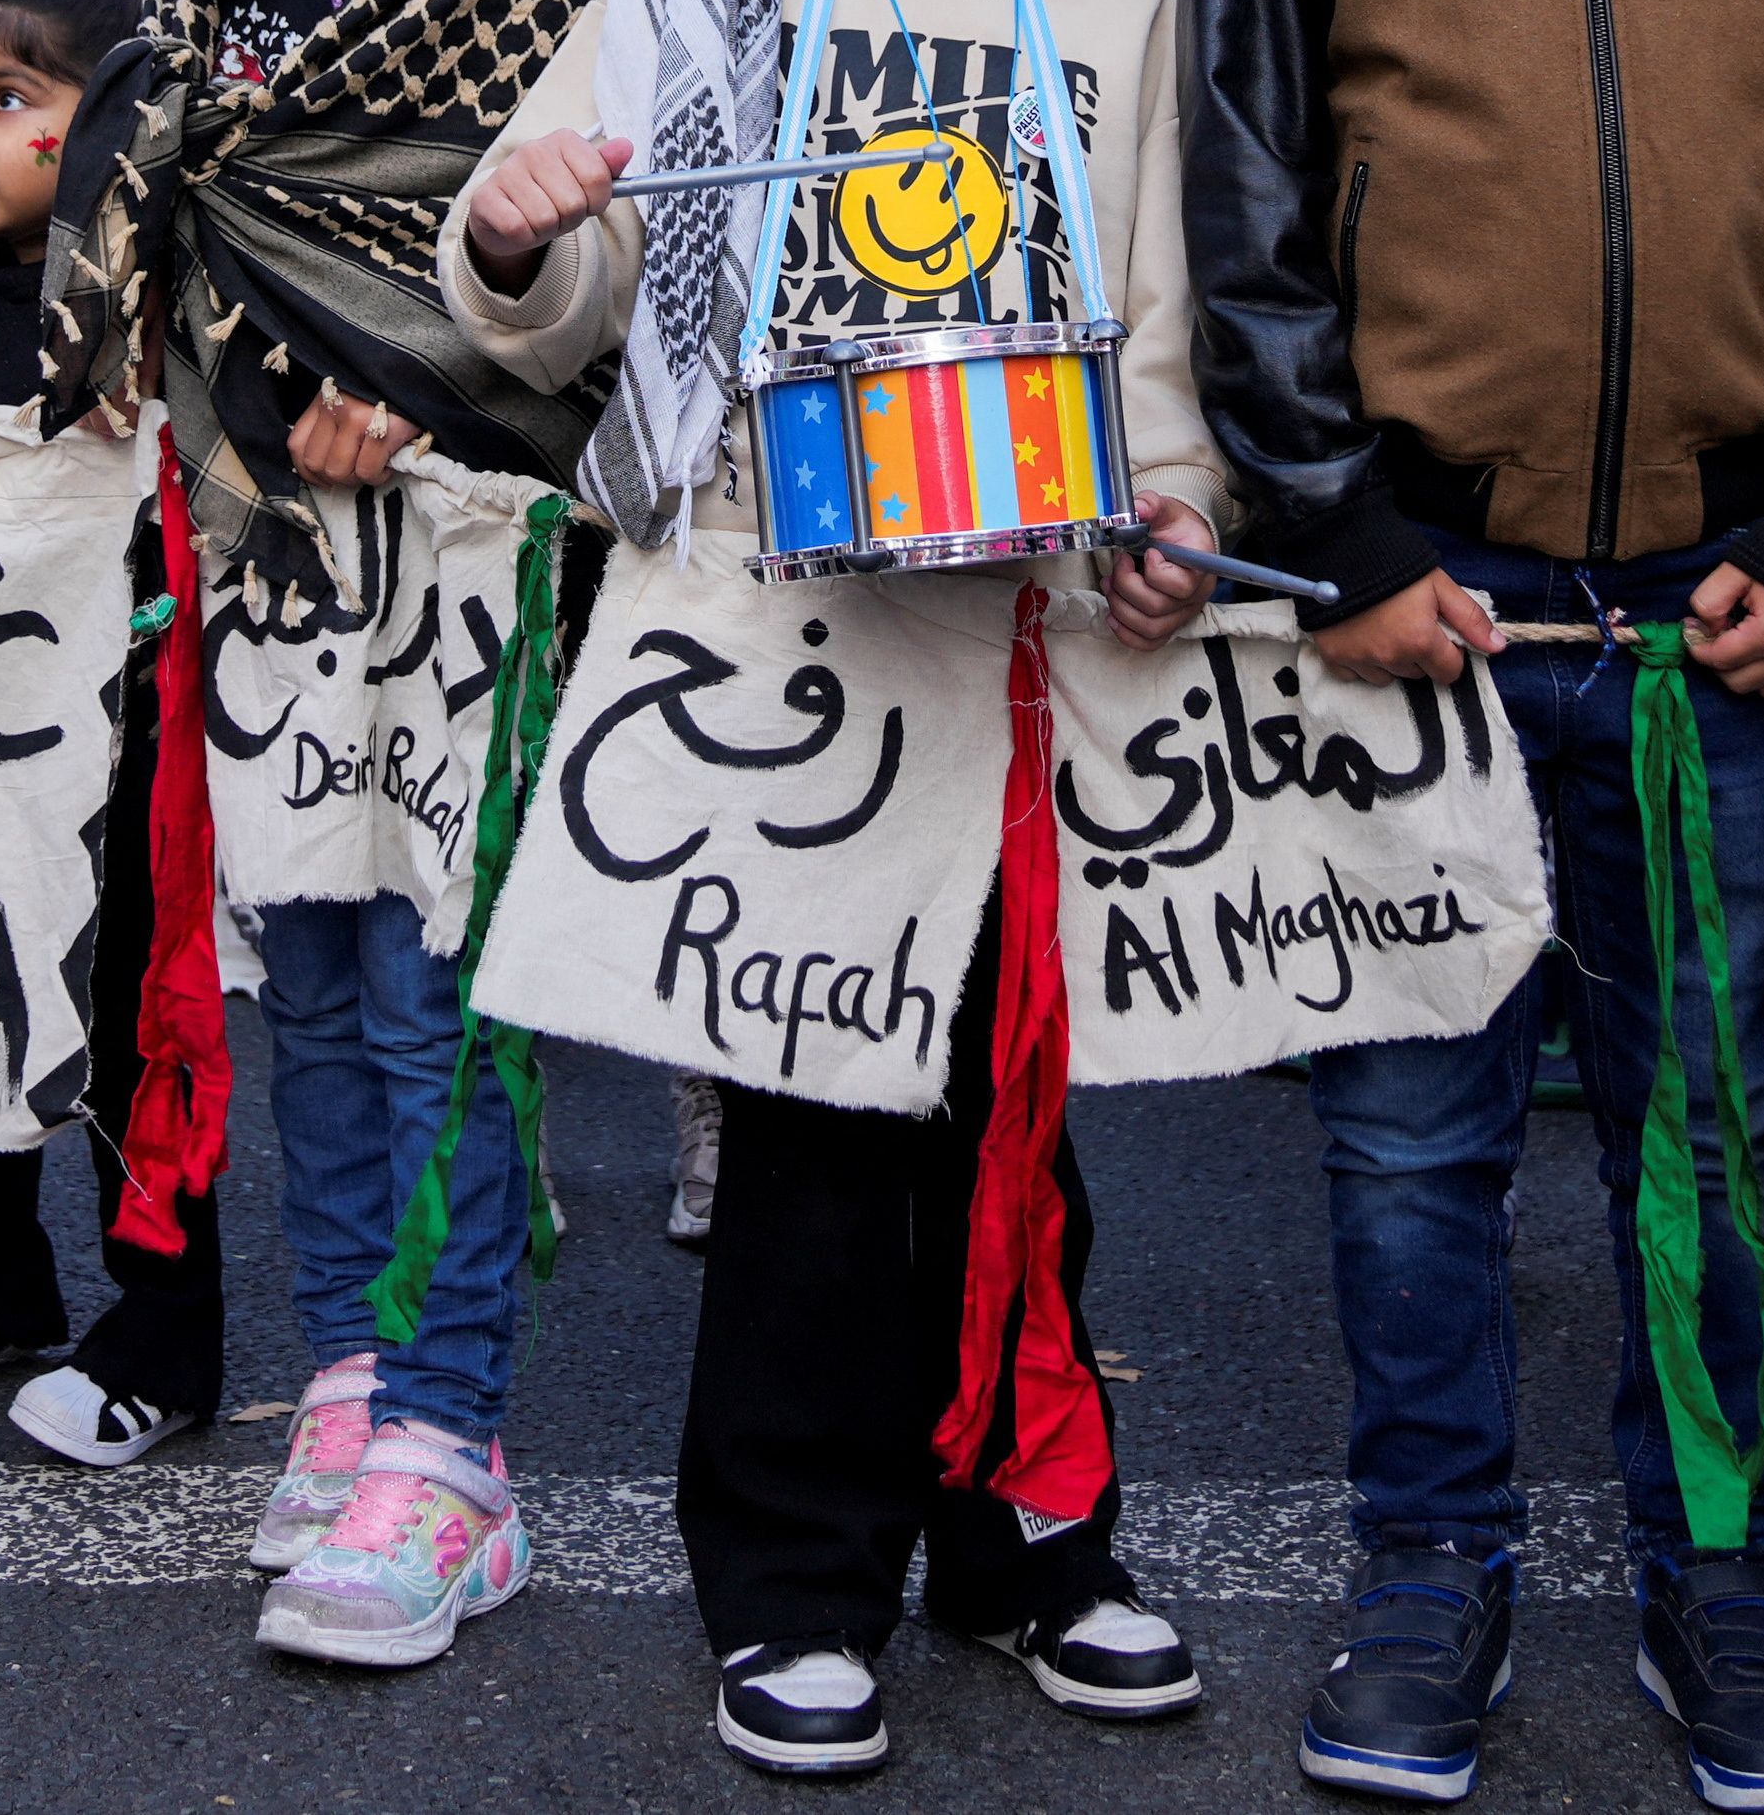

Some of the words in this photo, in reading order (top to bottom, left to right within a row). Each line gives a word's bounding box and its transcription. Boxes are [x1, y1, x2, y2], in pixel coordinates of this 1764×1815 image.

[1015, 103, 1040, 134] PALEST
[1022, 126, 1038, 141] WILL
[559, 618, 904, 883] رفح
[1055, 636, 1492, 890] المغازي
[655, 875, 935, 1080] Rafah
[1104, 897, 1200, 1016] Al
[1215, 858, 1486, 1012] Maghazi
